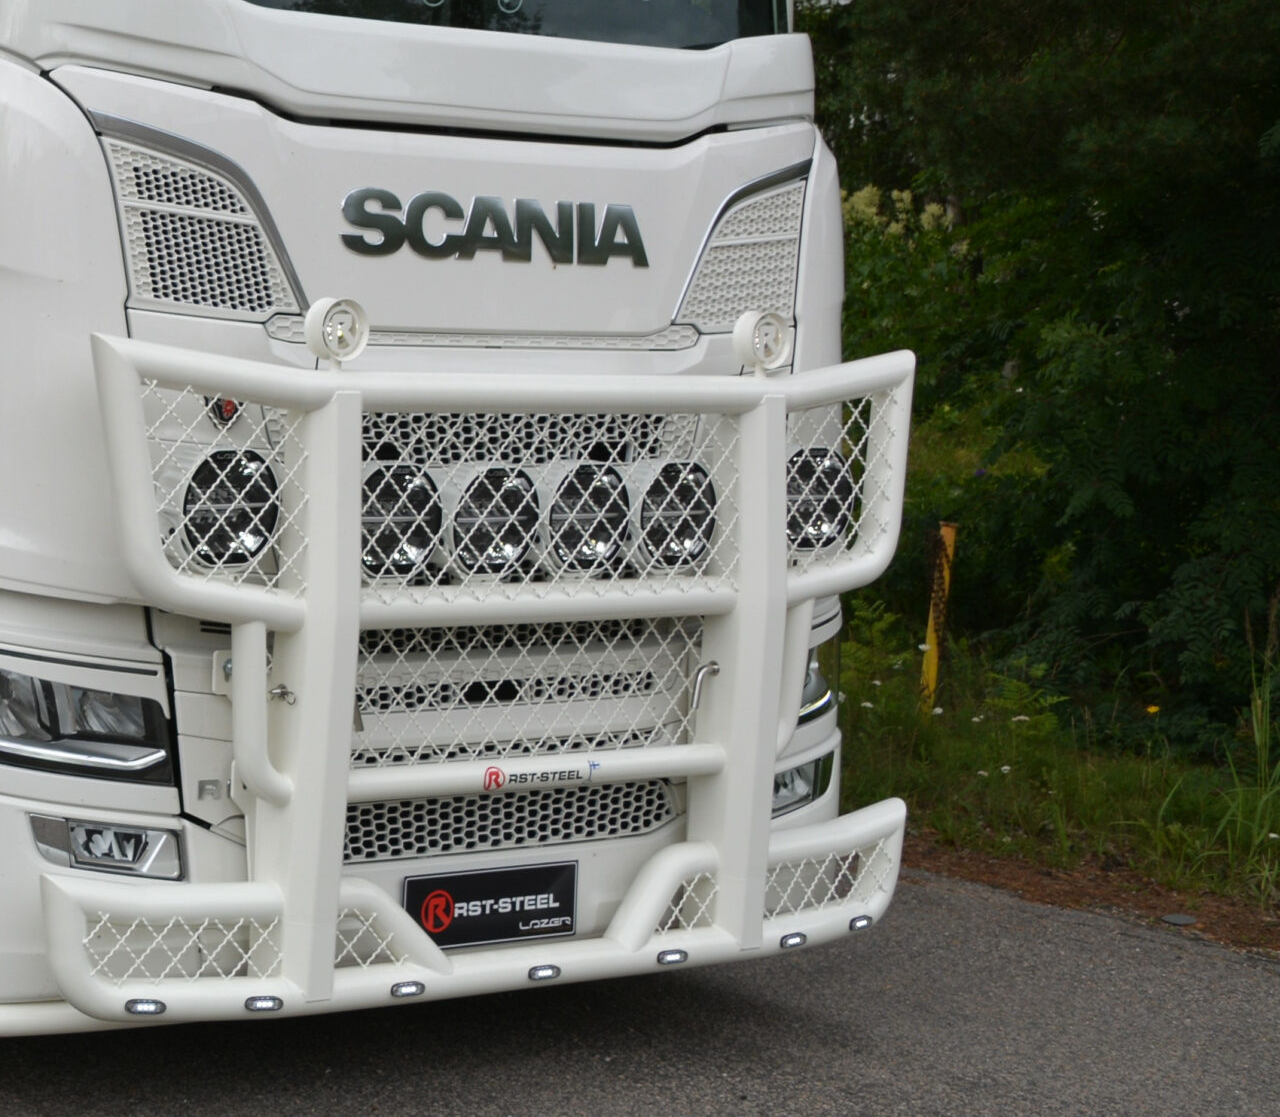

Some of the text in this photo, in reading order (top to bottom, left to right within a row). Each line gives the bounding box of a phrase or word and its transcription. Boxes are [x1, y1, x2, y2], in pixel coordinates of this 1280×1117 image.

[339, 187, 650, 268] SCANIA
[508, 769, 583, 785] RST-STEEL
[454, 893, 560, 918] RST-STEEL
[519, 916, 571, 930] LAZER
